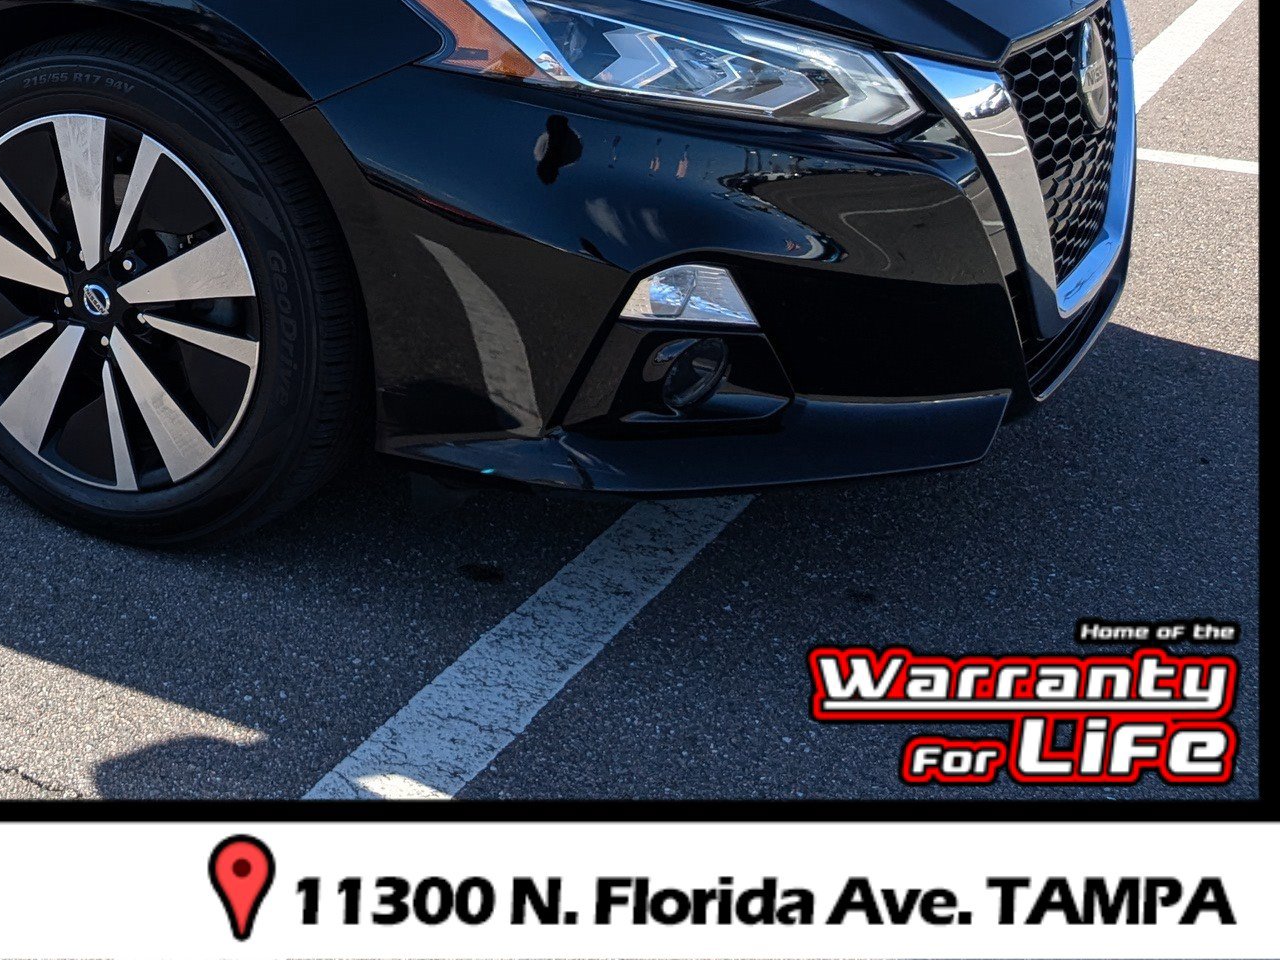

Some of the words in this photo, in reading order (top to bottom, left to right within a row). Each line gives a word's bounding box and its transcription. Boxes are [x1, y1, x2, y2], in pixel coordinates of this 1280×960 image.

[22, 72, 68, 89] 215/55
[73, 72, 102, 85] R17
[105, 77, 136, 93] 94V
